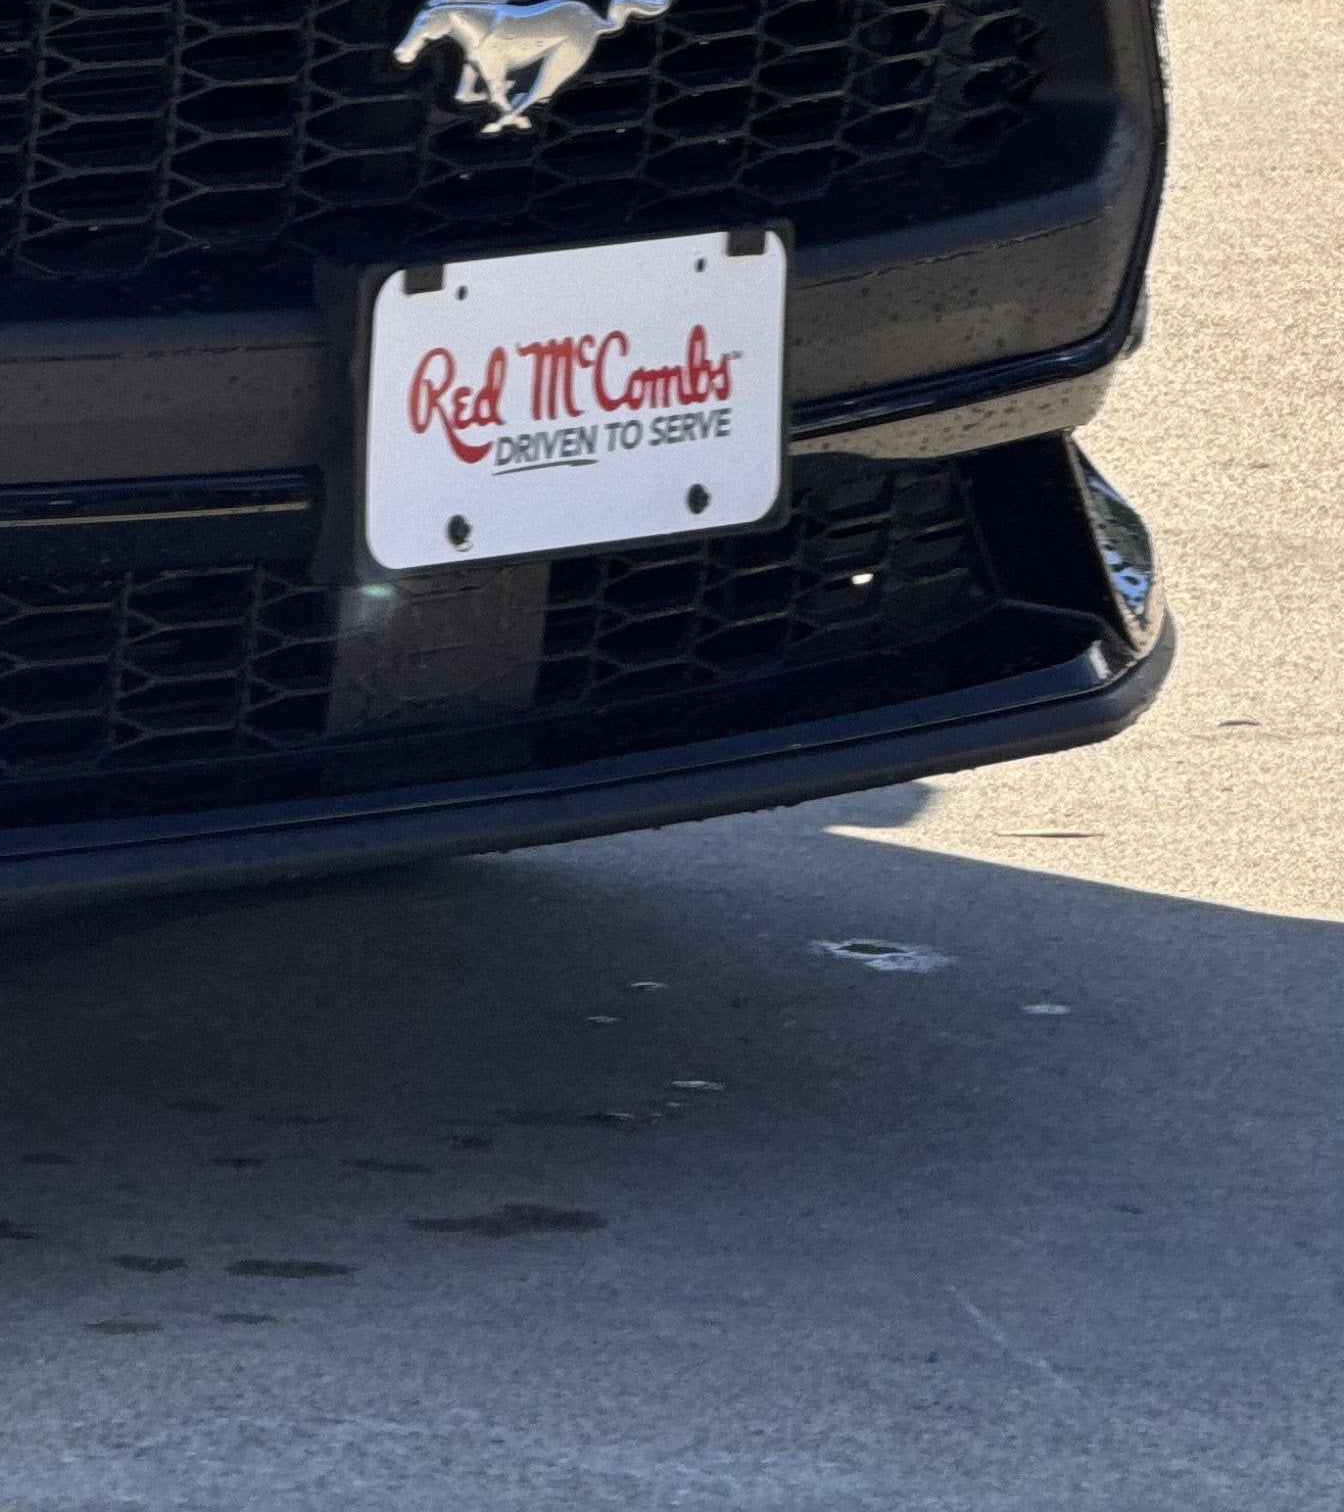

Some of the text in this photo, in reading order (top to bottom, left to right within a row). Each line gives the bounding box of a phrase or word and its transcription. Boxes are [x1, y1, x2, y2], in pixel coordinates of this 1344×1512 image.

[408, 346, 506, 463] Red
[493, 408, 733, 466] DRIVEN TO SERVE
